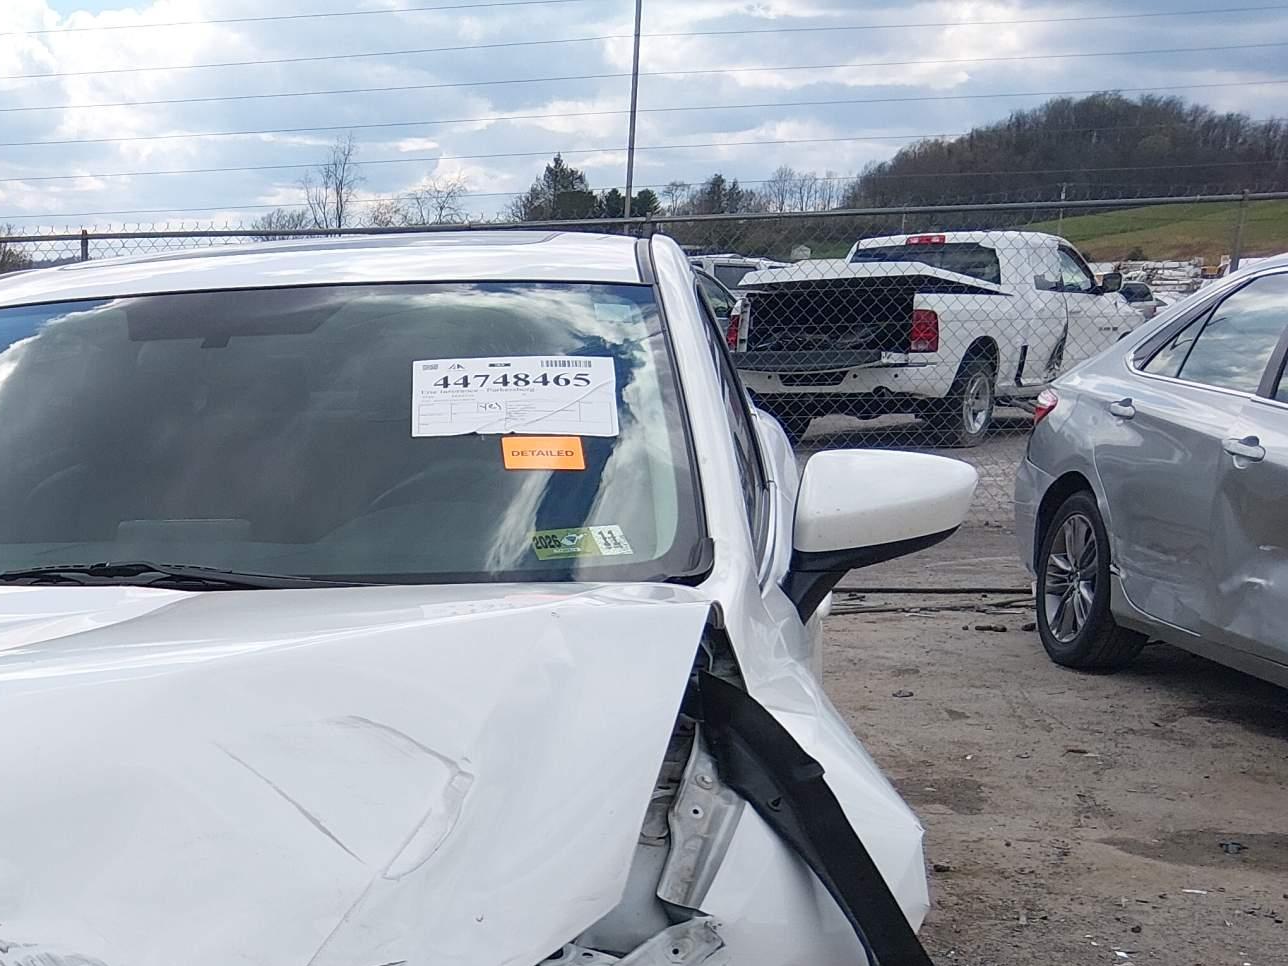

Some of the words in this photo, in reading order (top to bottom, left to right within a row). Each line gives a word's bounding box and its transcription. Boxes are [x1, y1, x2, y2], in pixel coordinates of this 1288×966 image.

[433, 372, 591, 388] 44748465
[511, 449, 575, 457] DETAILED
[532, 534, 562, 550] 2026
